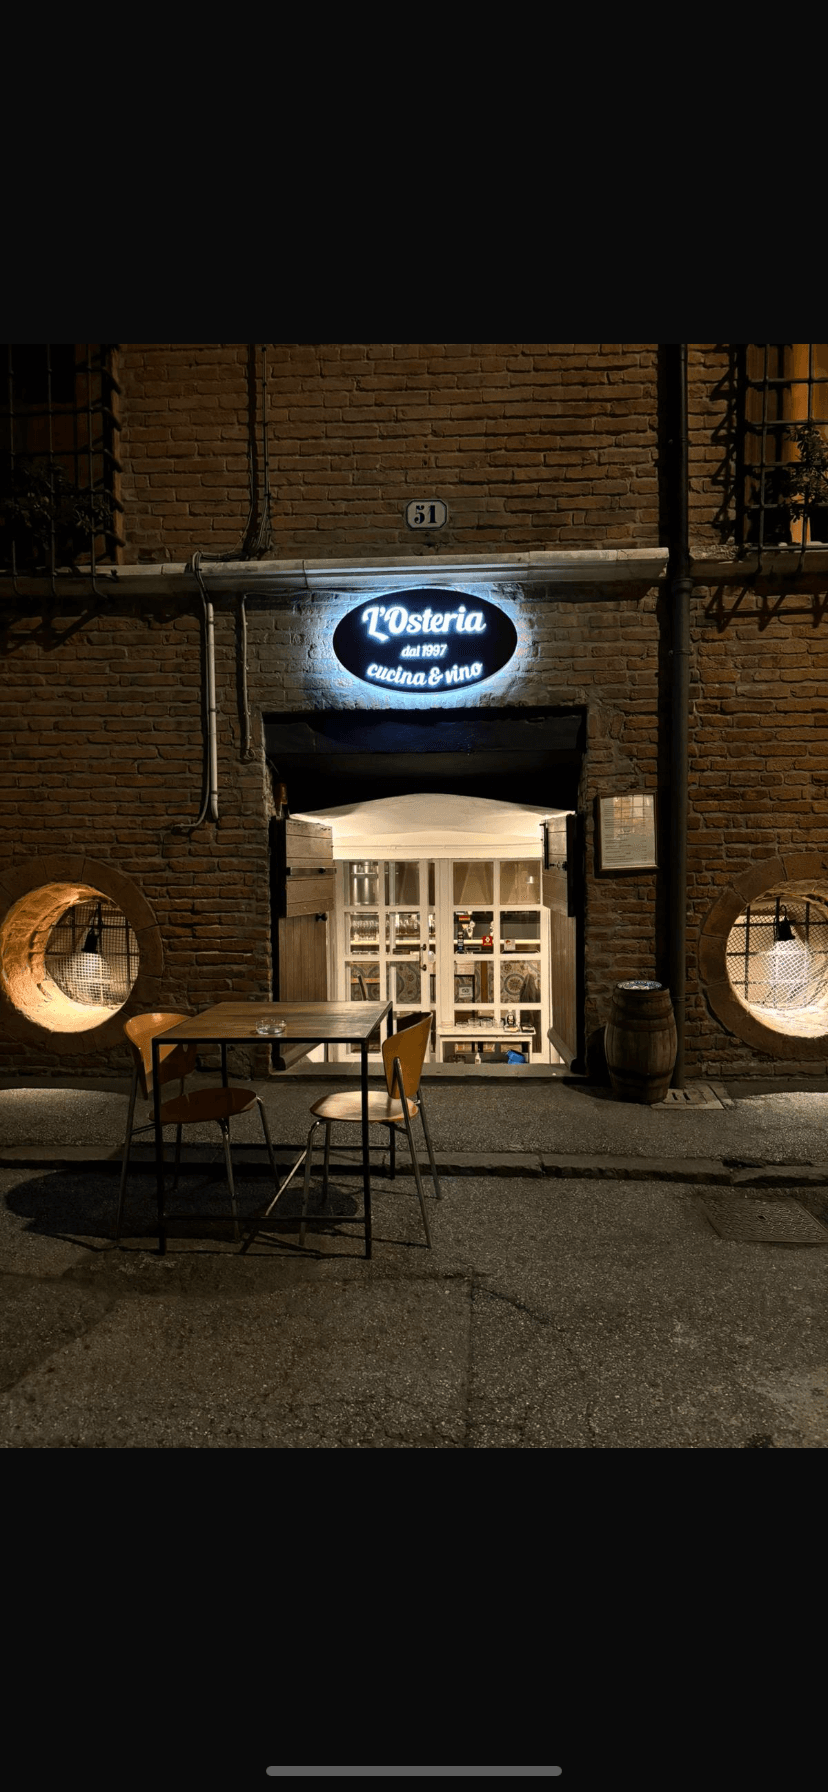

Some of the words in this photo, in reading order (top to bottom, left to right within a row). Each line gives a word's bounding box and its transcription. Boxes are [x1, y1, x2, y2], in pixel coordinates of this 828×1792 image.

[414, 505, 437, 524] 51
[362, 605, 486, 642] L'Osteria
[401, 645, 420, 658] dal
[421, 643, 447, 657] 1997
[366, 662, 427, 686] cucina
[428, 667, 443, 686] &
[444, 661, 484, 684] vino
